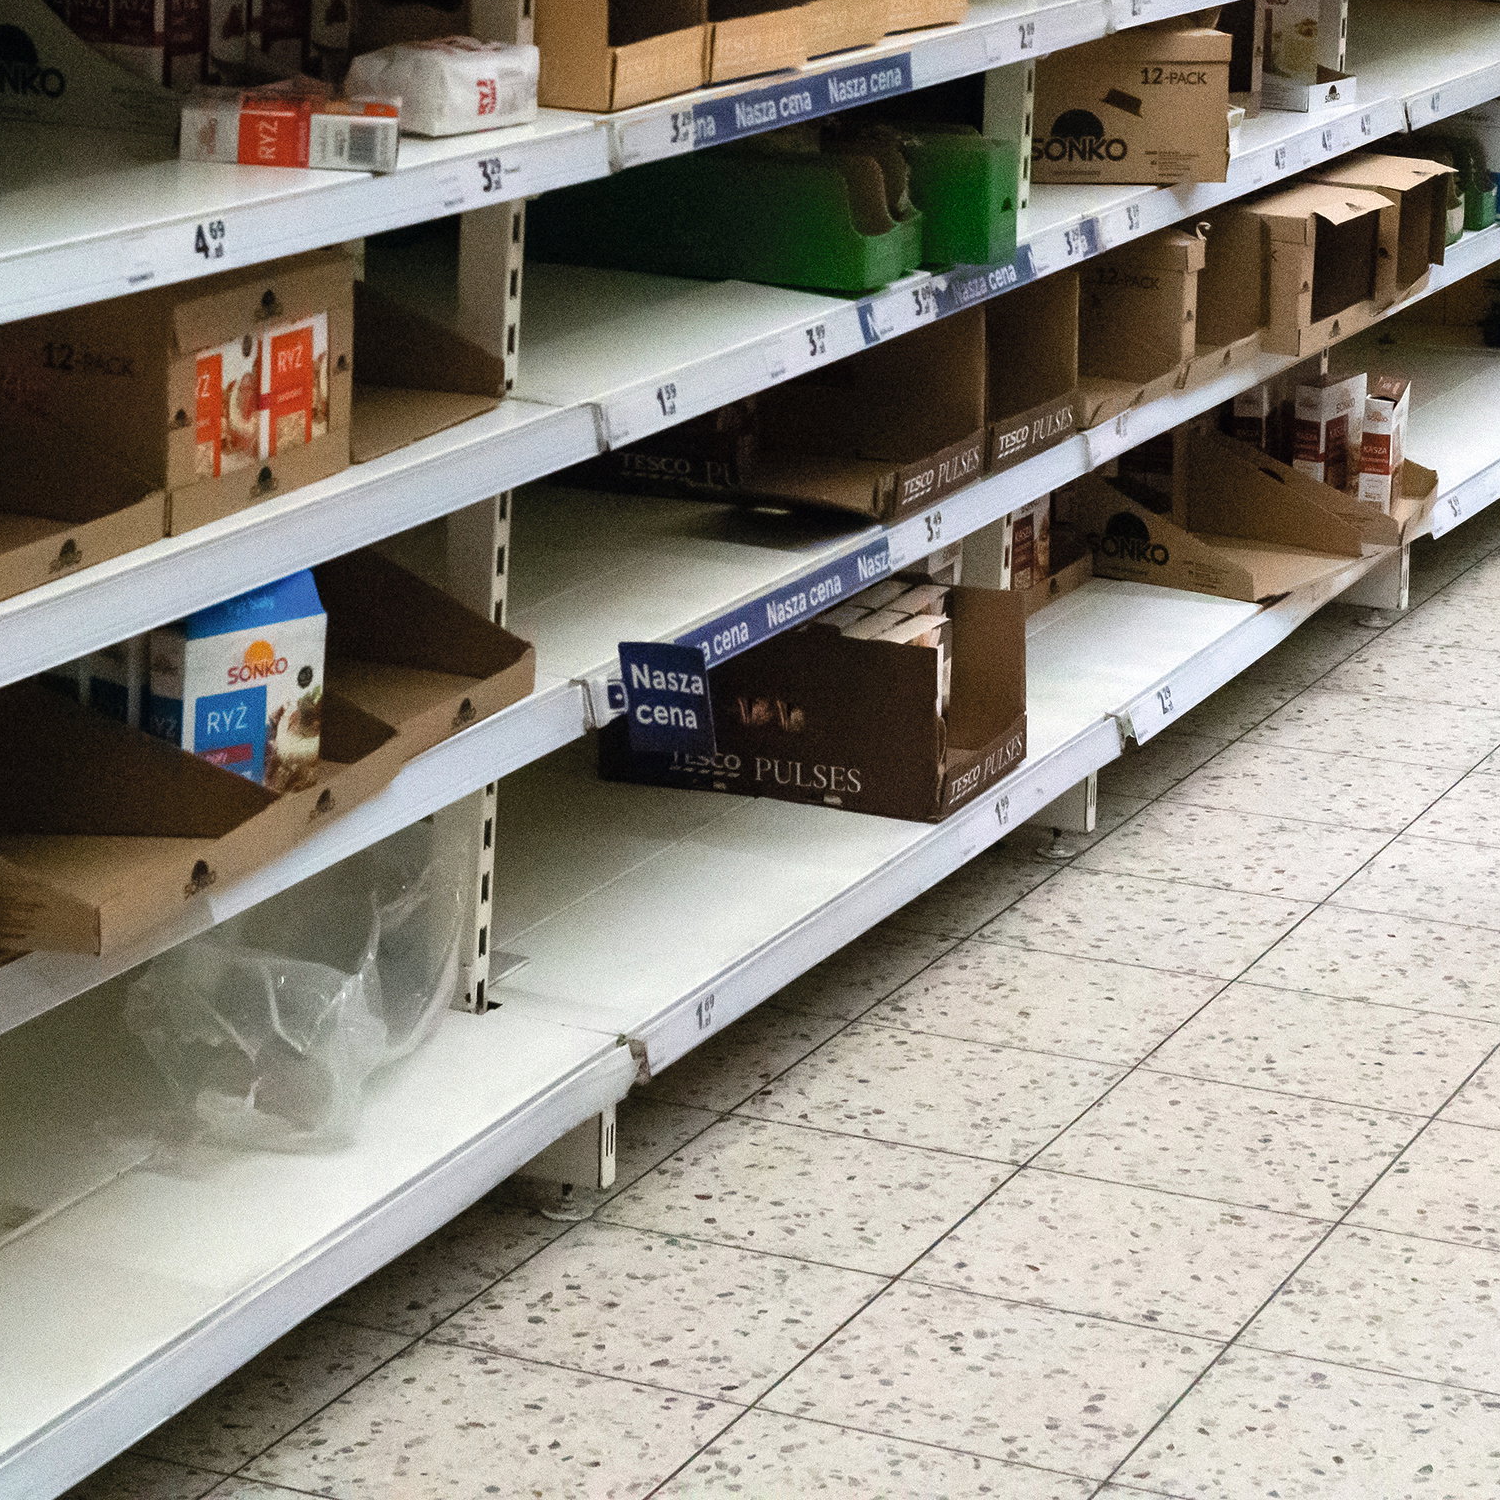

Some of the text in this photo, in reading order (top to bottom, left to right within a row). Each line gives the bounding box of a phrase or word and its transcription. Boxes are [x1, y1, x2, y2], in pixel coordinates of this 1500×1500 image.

[1140, 67, 1207, 86] 12-PACK
[734, 100, 776, 130] Nasza
[827, 77, 867, 105] Nasza
[869, 66, 903, 92] cena
[257, 116, 280, 160] RYŻ
[1030, 136, 1128, 162] SONKO
[989, 265, 1017, 289] cena
[276, 344, 303, 374] RYŻ
[998, 403, 1075, 451] TESCO PULSES
[904, 447, 981, 496] TESCO PULSES
[1089, 533, 1170, 567] SONKO
[713, 620, 750, 655] cena
[766, 593, 807, 630] Nasza
[809, 574, 843, 607] cena
[226, 656, 289, 686] SONKO
[630, 662, 705, 696] Nasza
[206, 703, 249, 736] RYŻ
[635, 704, 699, 731] cena
[754, 757, 863, 794] PULSES
[950, 735, 1025, 795] TESCO PULSES
